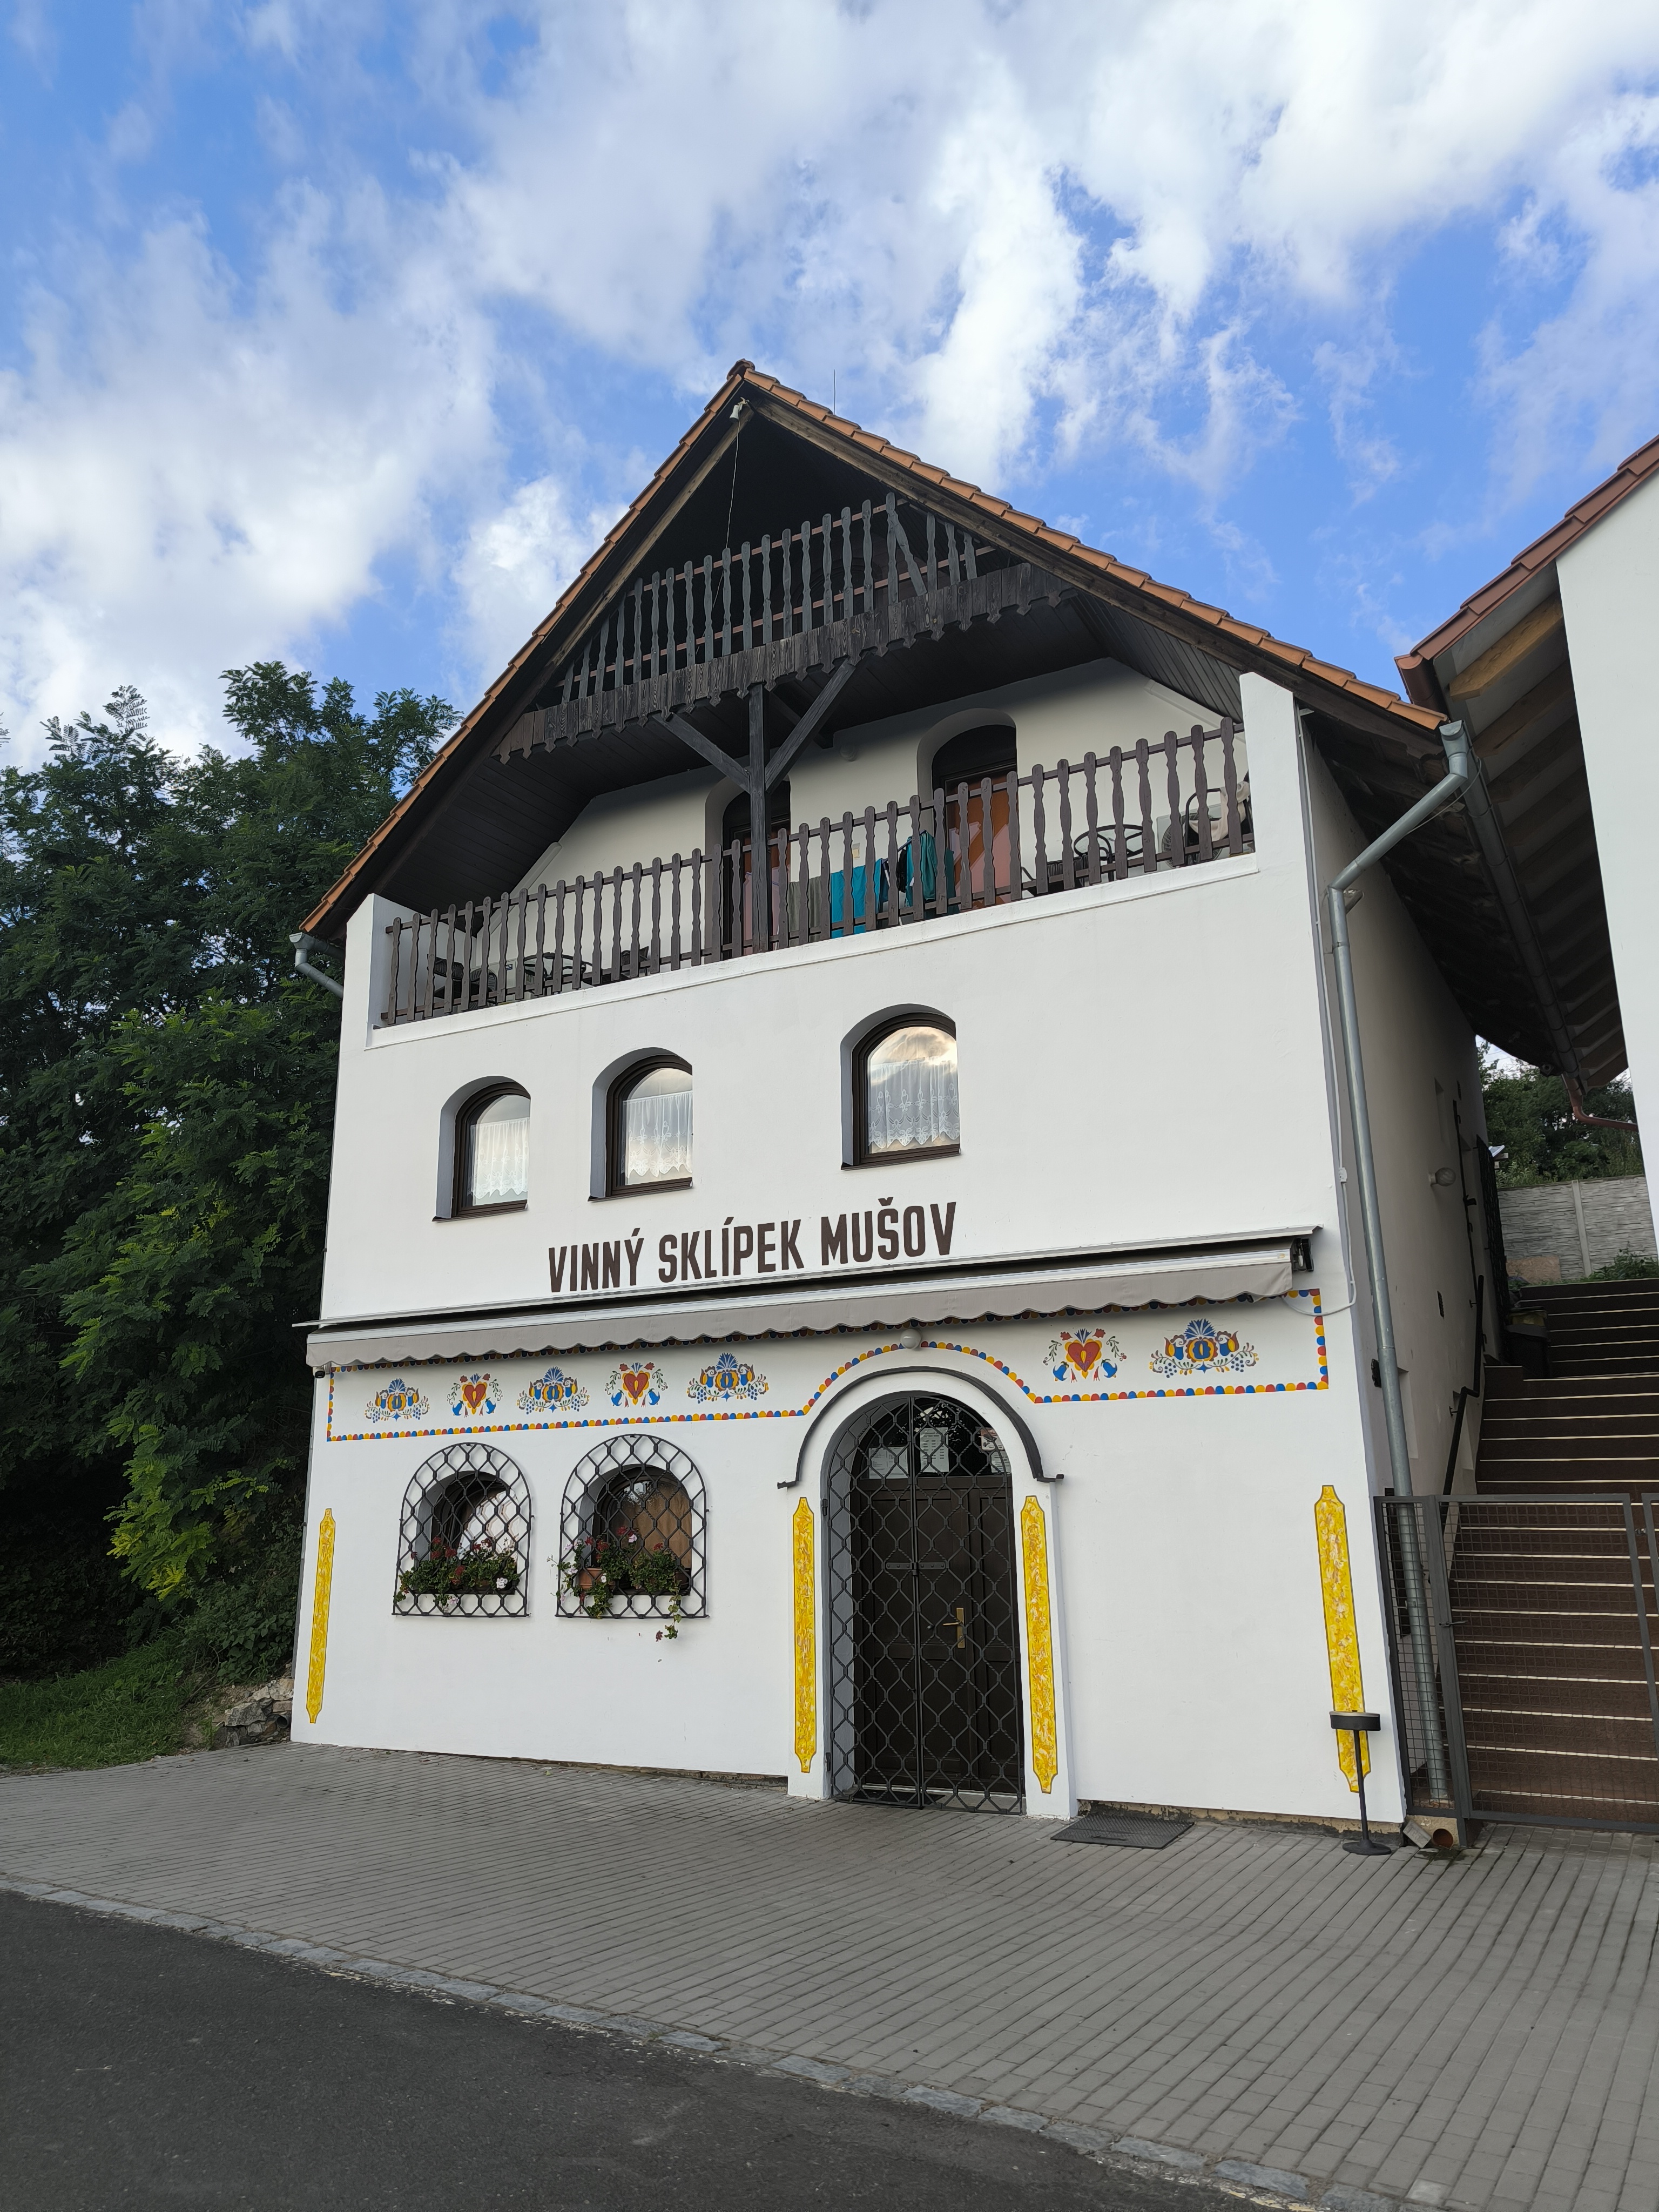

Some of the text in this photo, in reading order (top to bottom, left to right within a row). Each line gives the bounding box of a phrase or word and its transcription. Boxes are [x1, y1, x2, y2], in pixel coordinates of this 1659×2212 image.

[549, 1196, 956, 1293] VINNÝ SKLÍPEK MUŠOV
